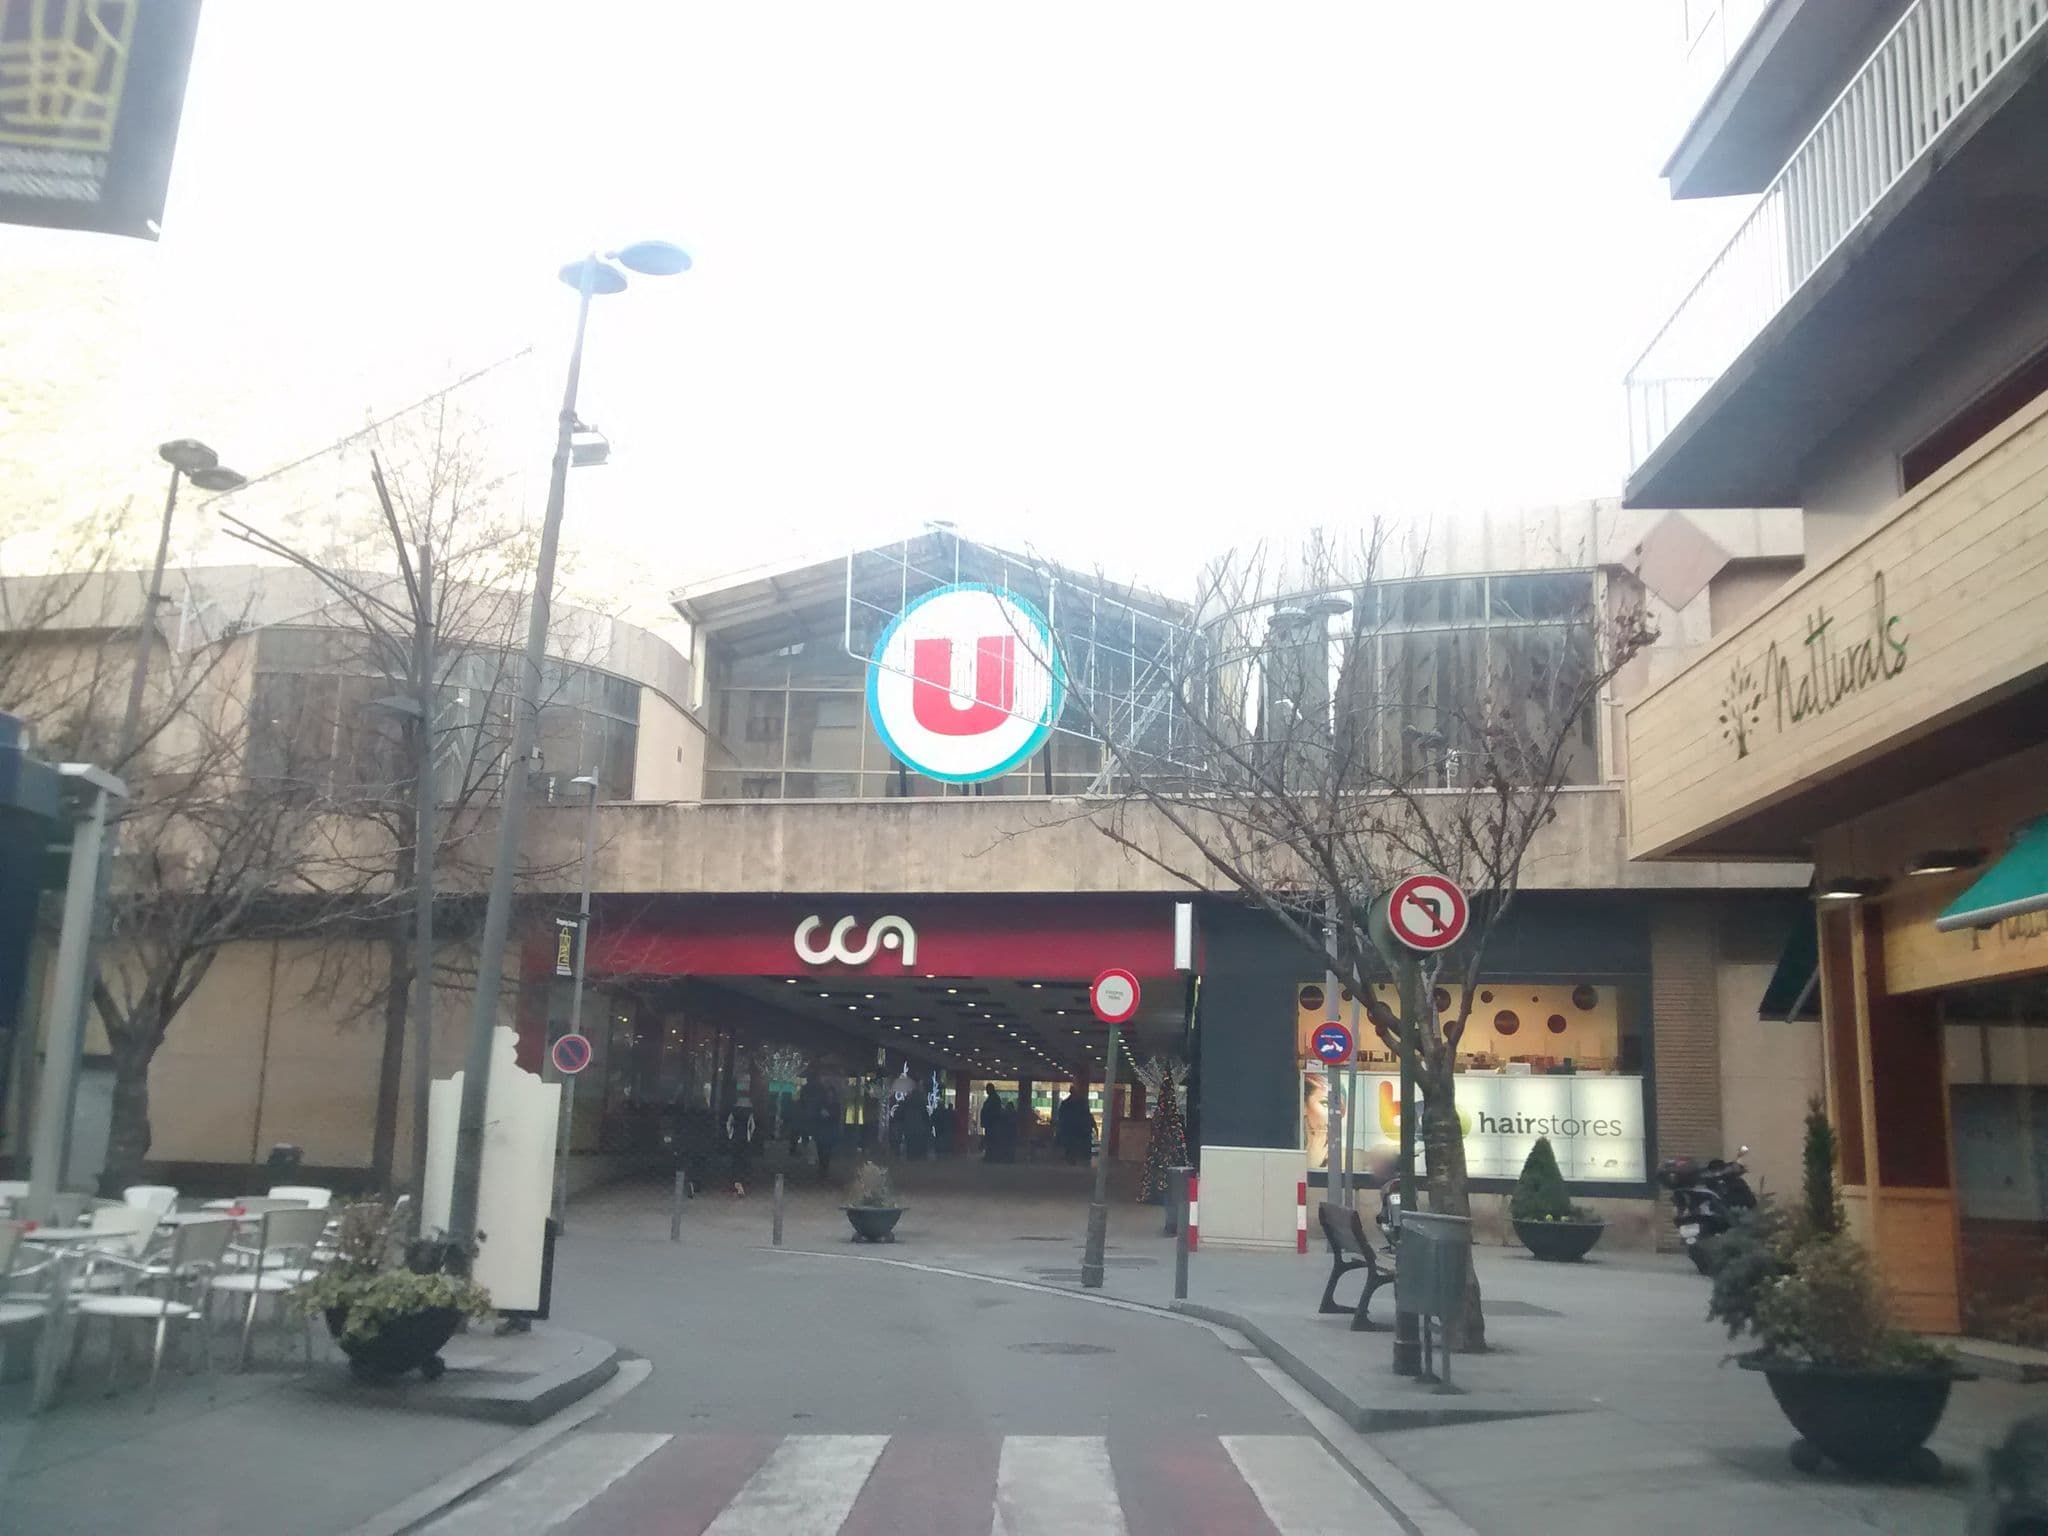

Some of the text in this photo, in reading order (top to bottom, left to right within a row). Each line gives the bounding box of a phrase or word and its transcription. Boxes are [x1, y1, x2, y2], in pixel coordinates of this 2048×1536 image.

[912, 634, 1016, 737] U
[1764, 570, 1910, 733] Natturals
[1478, 1111, 1623, 1138] hairstores
